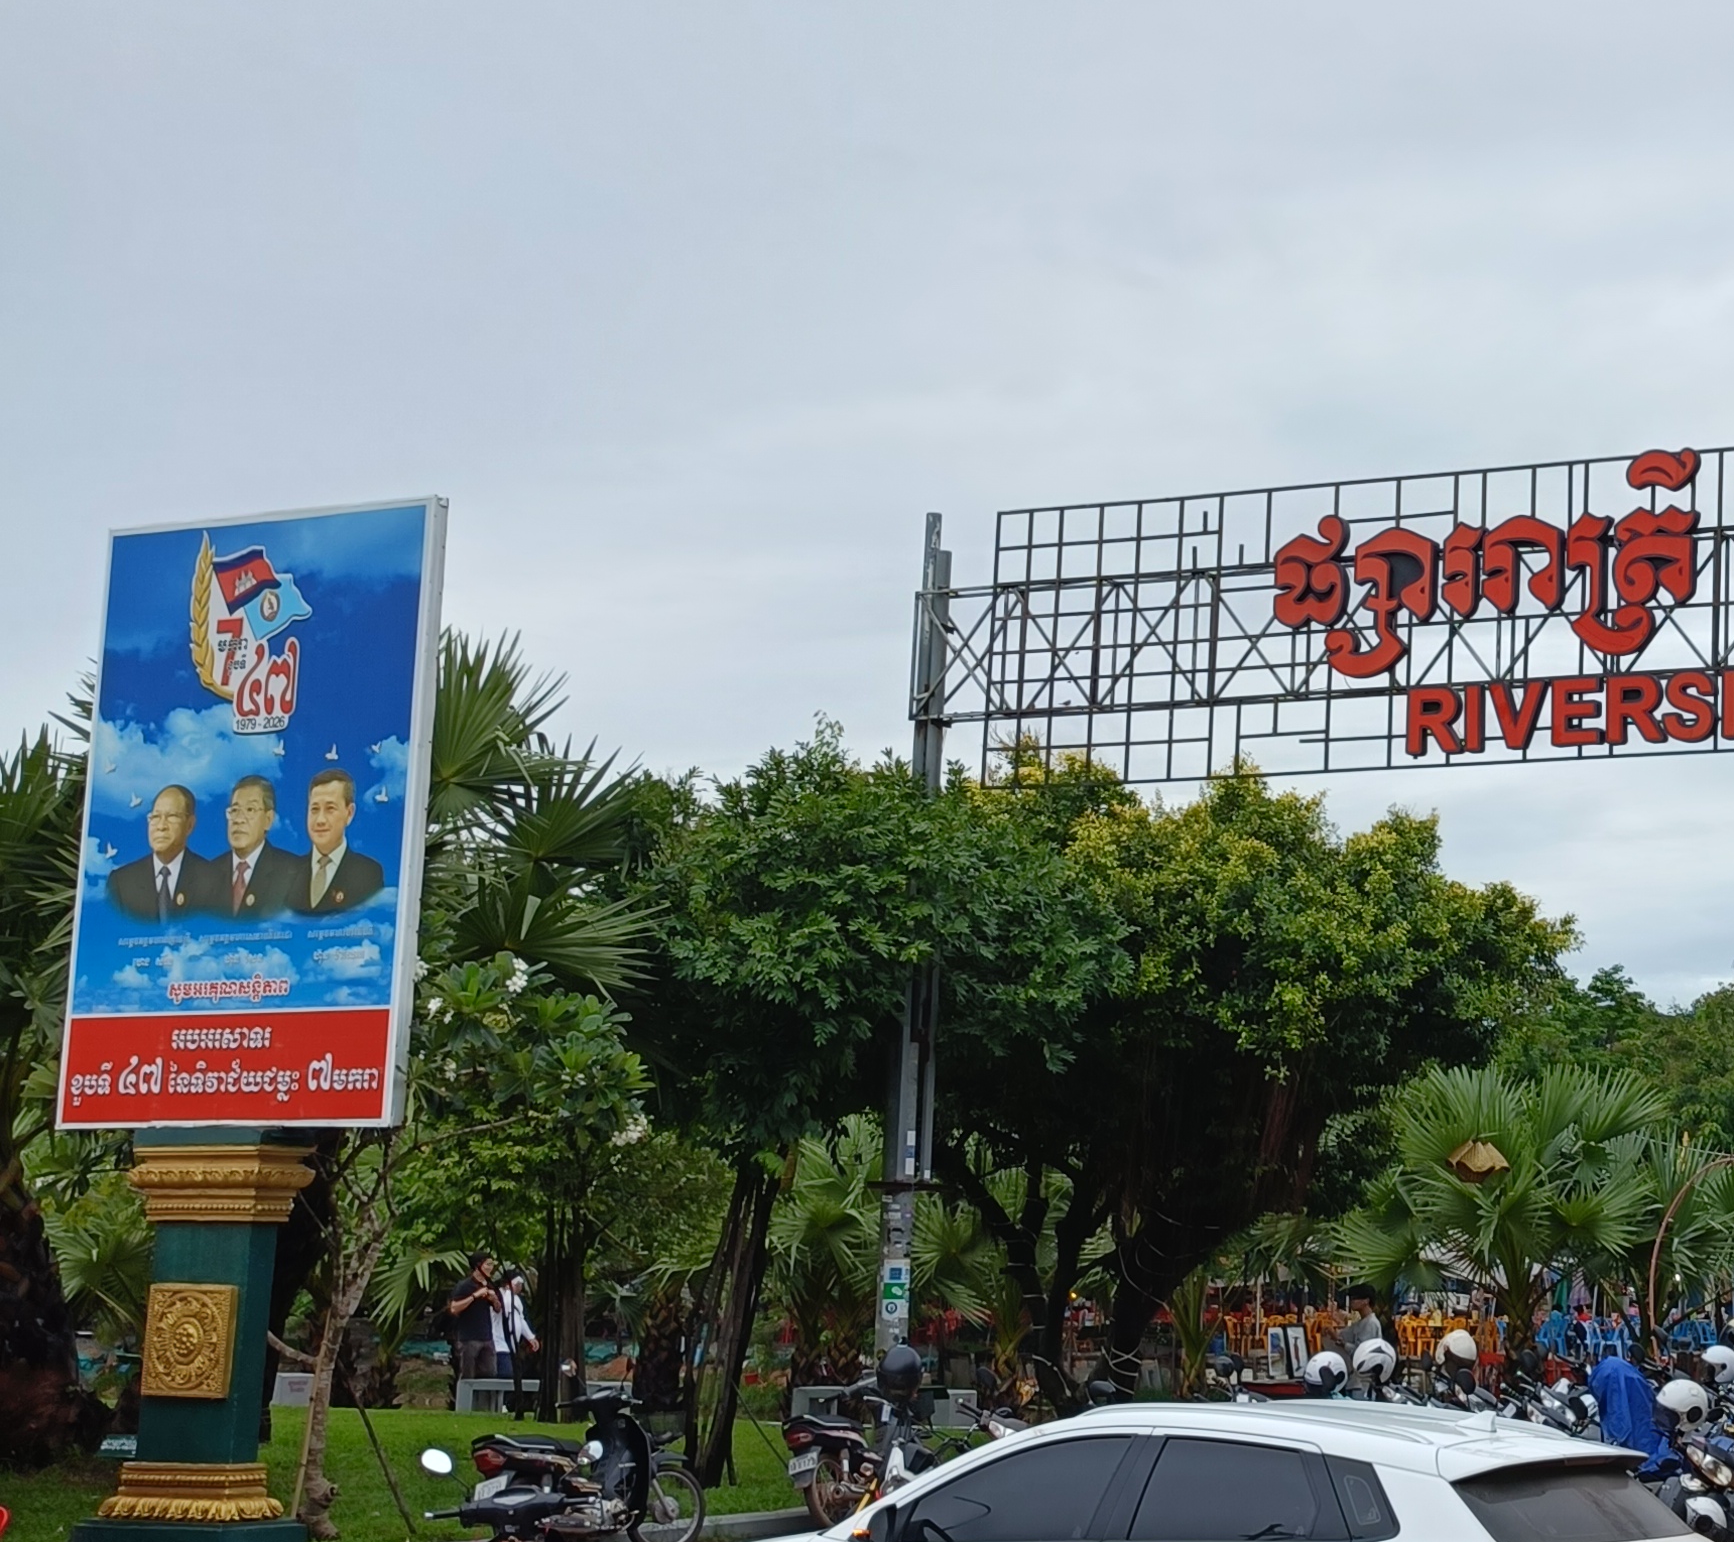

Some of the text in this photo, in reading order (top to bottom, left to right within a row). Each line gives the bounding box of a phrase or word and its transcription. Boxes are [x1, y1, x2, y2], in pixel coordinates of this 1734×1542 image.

[236, 640, 298, 718] ៤៧
[235, 718, 257, 731] 1979
[263, 716, 286, 730] 2026
[171, 1026, 273, 1050] អបអរសាទរ
[70, 1061, 114, 1107] ខួបទី
[118, 1055, 164, 1095] ៤៧
